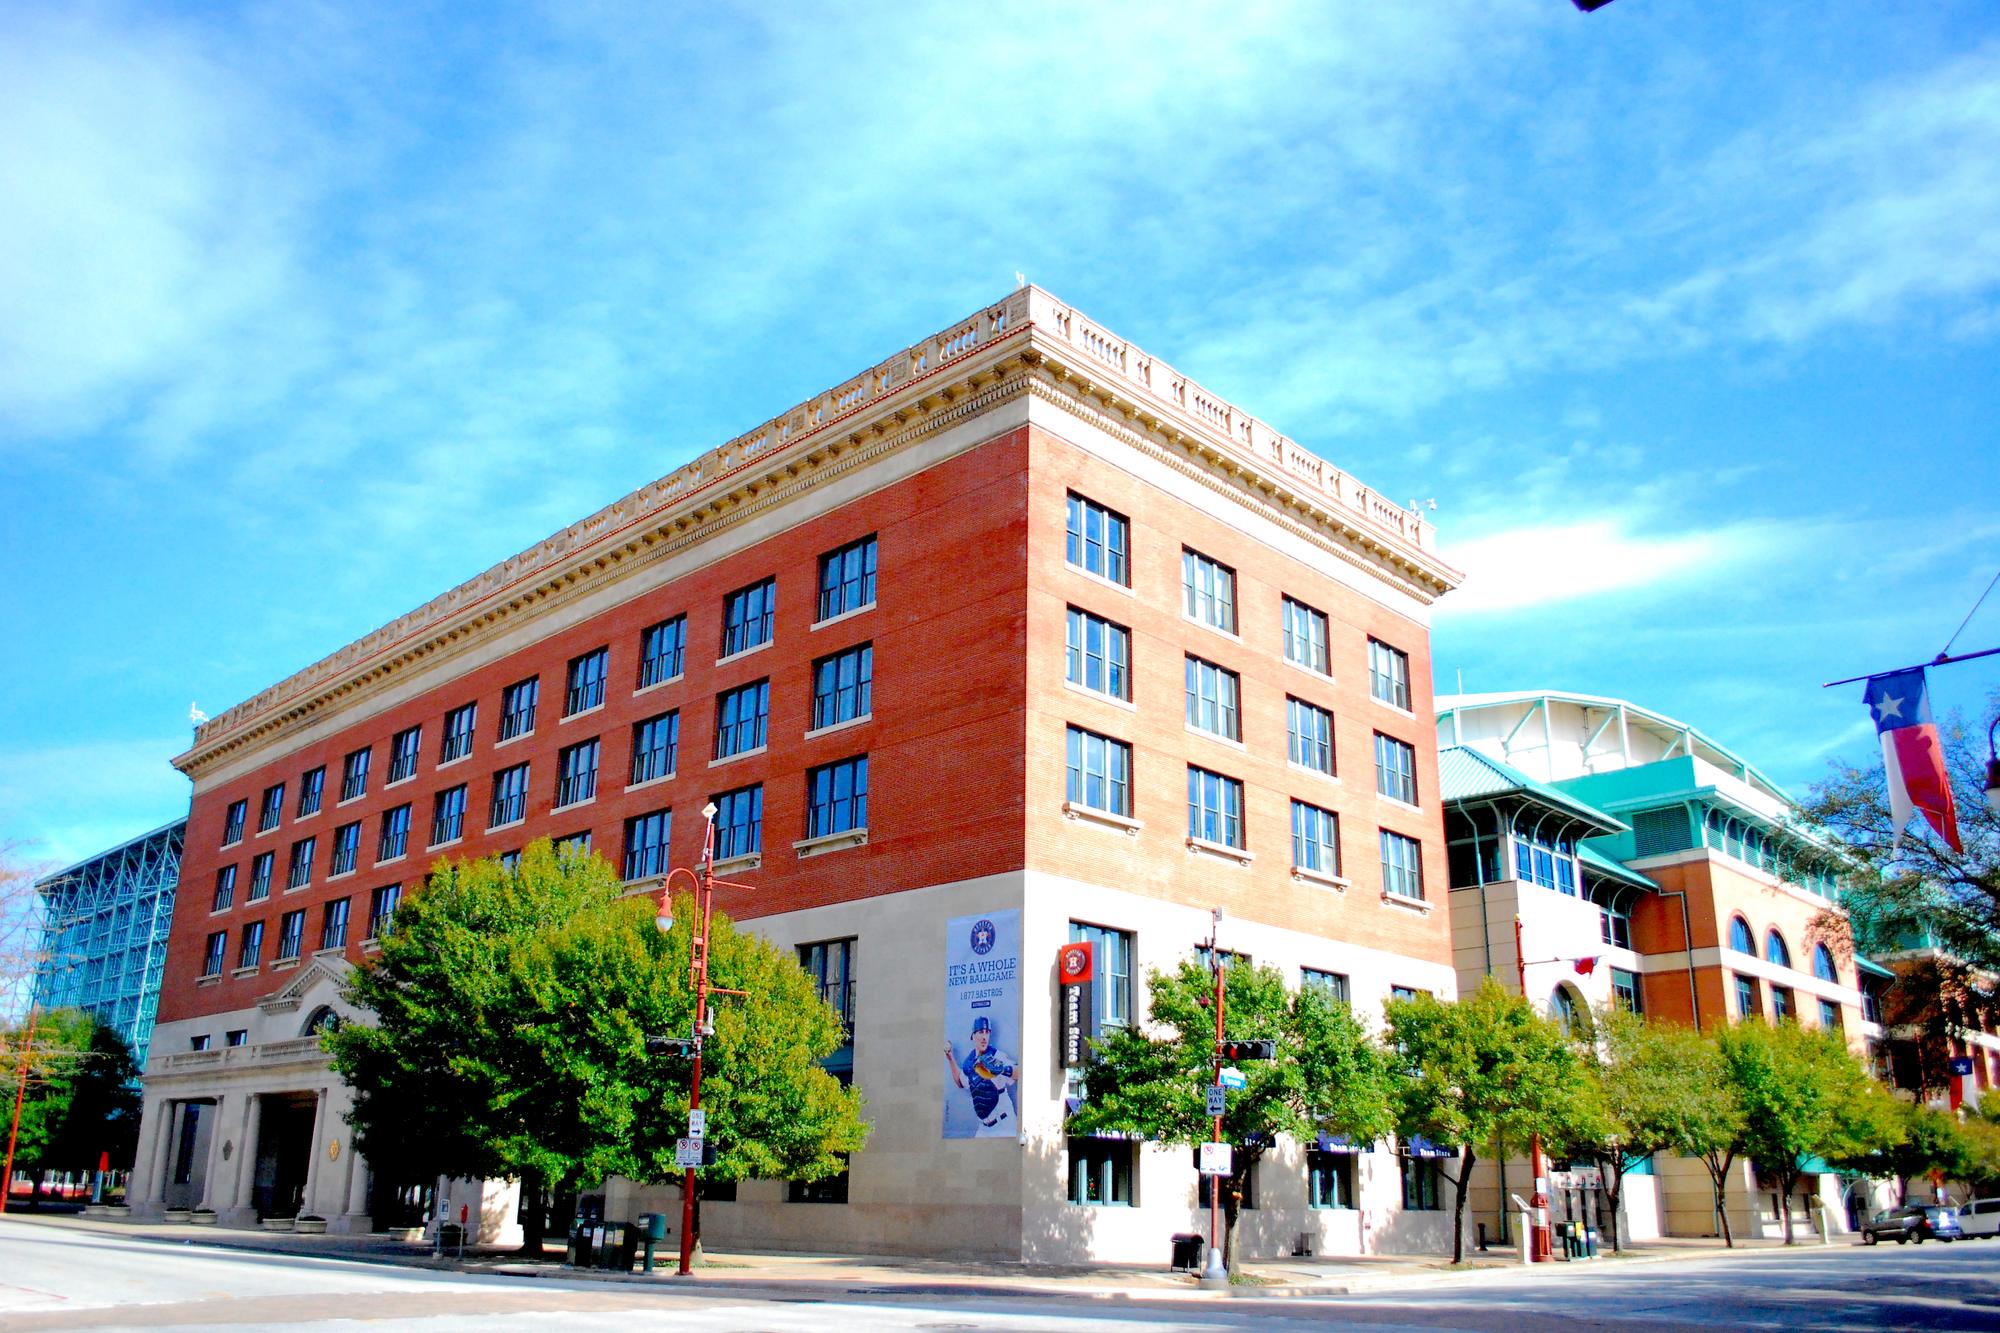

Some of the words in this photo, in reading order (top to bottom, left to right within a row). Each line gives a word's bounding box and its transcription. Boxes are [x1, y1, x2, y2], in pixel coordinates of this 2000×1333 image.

[949, 964, 966, 976] IT'S
[969, 963, 976, 974] A
[977, 957, 1017, 973] WHOLE
[949, 976, 967, 987] NEW
[1068, 985, 1080, 1025] Team
[1068, 1026, 1080, 1062] Store
[1208, 1088, 1222, 1096] ONE
[1208, 1096, 1223, 1104] WAY
